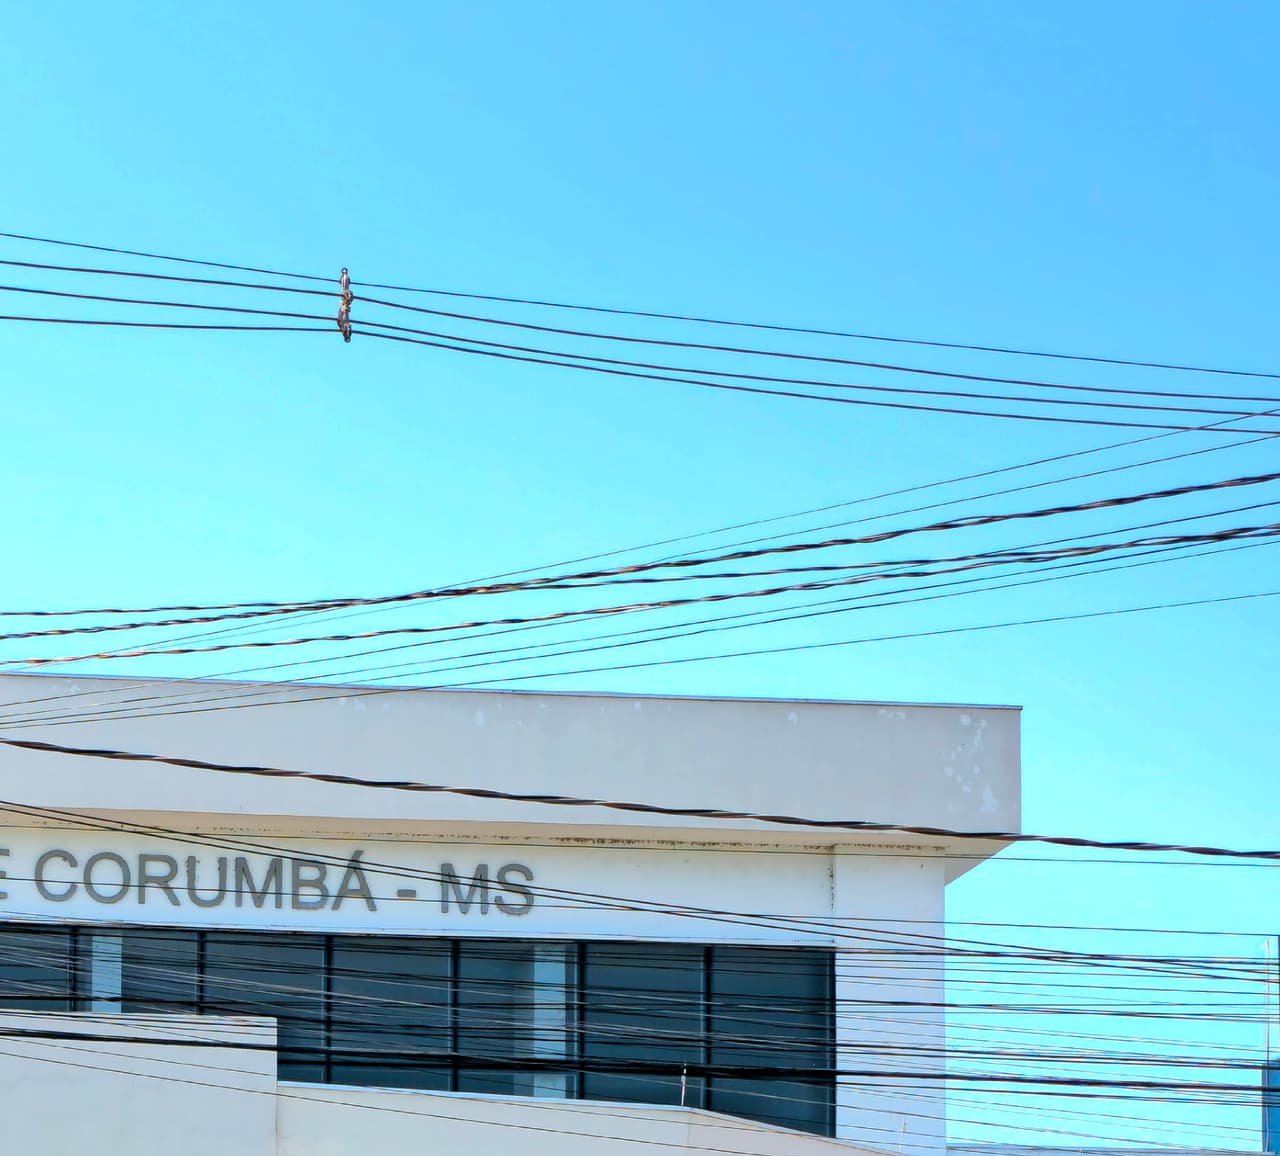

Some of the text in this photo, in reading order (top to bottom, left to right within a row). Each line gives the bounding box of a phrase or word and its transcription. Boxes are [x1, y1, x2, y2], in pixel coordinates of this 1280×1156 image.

[34, 849, 378, 913] CORUMBÁ
[396, 889, 417, 898] -
[439, 862, 535, 916] MS
